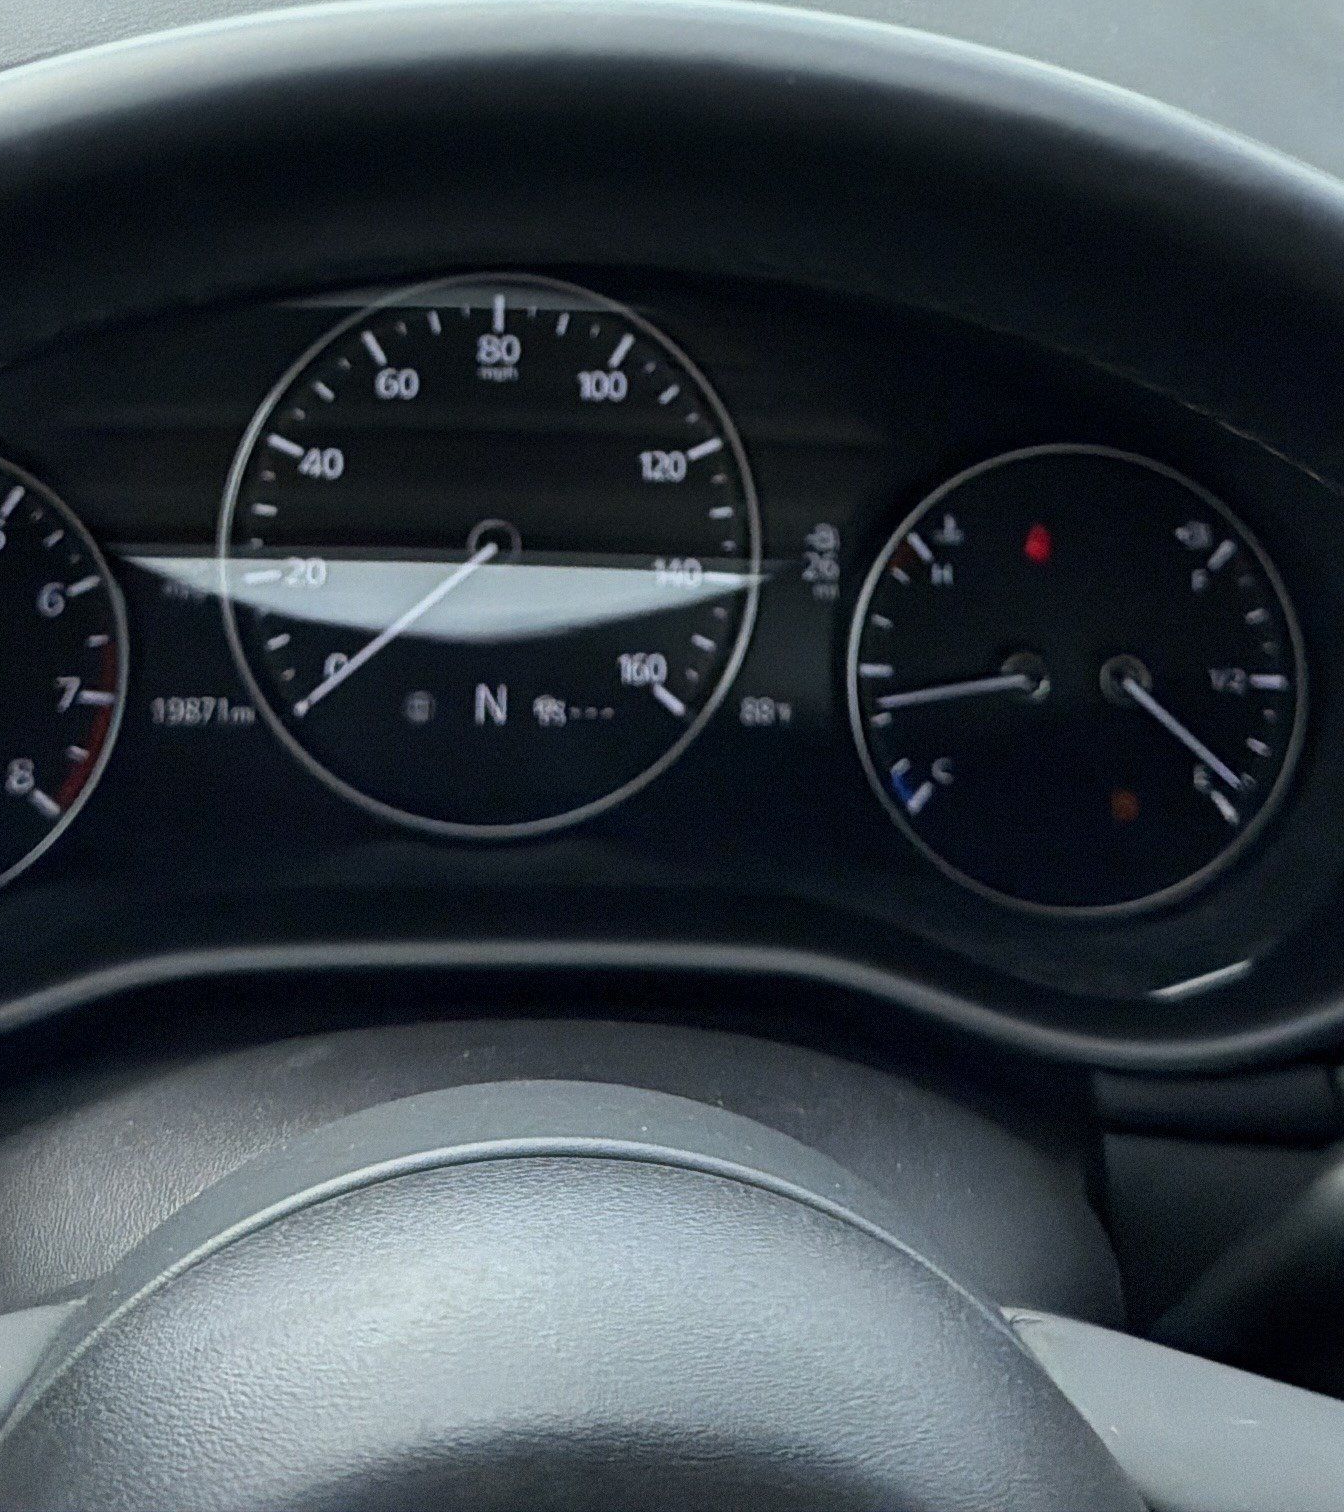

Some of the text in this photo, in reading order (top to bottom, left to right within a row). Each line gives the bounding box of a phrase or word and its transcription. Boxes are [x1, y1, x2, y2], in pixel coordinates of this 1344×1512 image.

[476, 334, 521, 364] 80
[376, 369, 419, 399] 60
[578, 371, 628, 402] 100
[299, 449, 345, 479] 40
[640, 452, 687, 482] 120
[282, 557, 326, 586] 20
[37, 582, 65, 617] 6
[617, 653, 668, 686] 160
[57, 676, 81, 712] 7
[475, 683, 507, 726] N
[6, 758, 35, 794] 8
